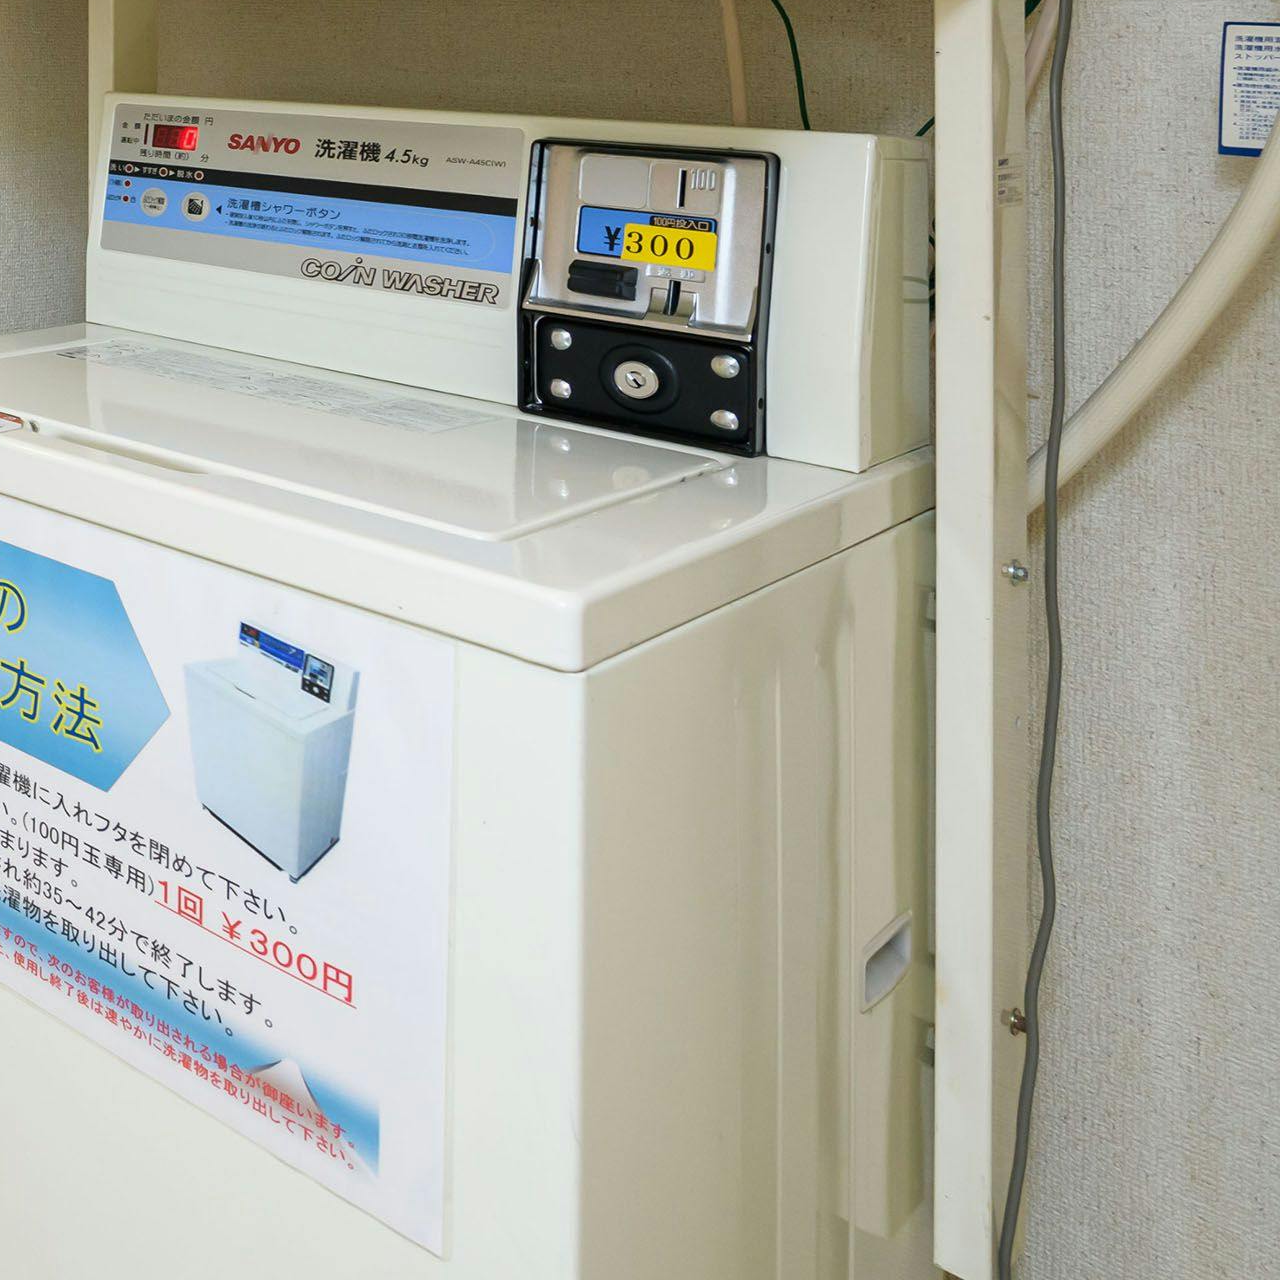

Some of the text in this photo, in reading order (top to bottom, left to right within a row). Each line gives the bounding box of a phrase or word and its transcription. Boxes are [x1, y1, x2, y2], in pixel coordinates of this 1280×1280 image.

[143, 112, 214, 126] ただいまの金額 円
[200, 153, 209, 163] 分
[228, 133, 301, 155] SANYO
[314, 139, 380, 163] 洗濯機
[385, 148, 429, 168] 4.5kg
[177, 169, 193, 180] 脱水
[227, 197, 340, 220] 洗濯槽シャワーボタン
[383, 269, 500, 304] WASHER
